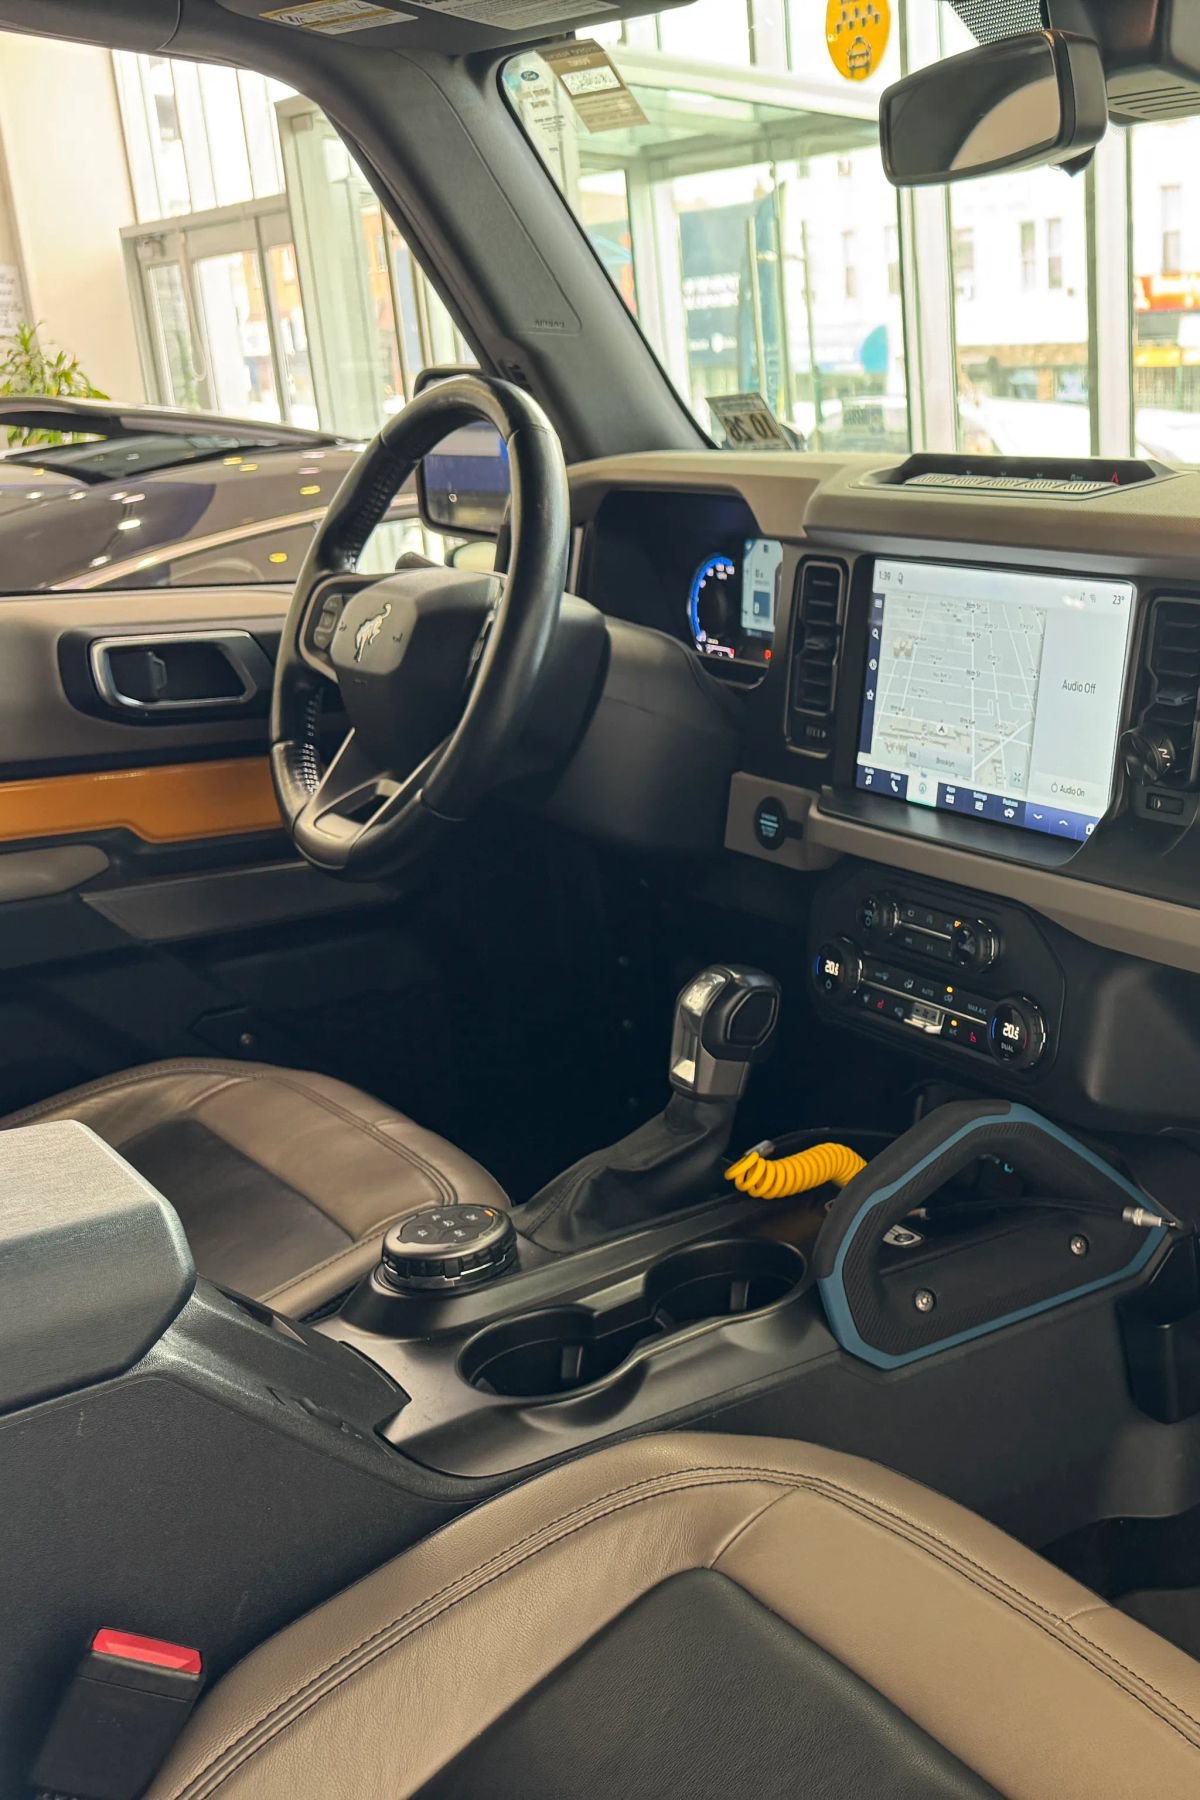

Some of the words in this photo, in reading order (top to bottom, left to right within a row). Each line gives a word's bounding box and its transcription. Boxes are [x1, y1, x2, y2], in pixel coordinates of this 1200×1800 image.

[1062, 680, 1083, 693] Audio
[1084, 682, 1096, 694] Off
[1060, 784, 1076, 796] Audio
[1076, 787, 1085, 797] On
